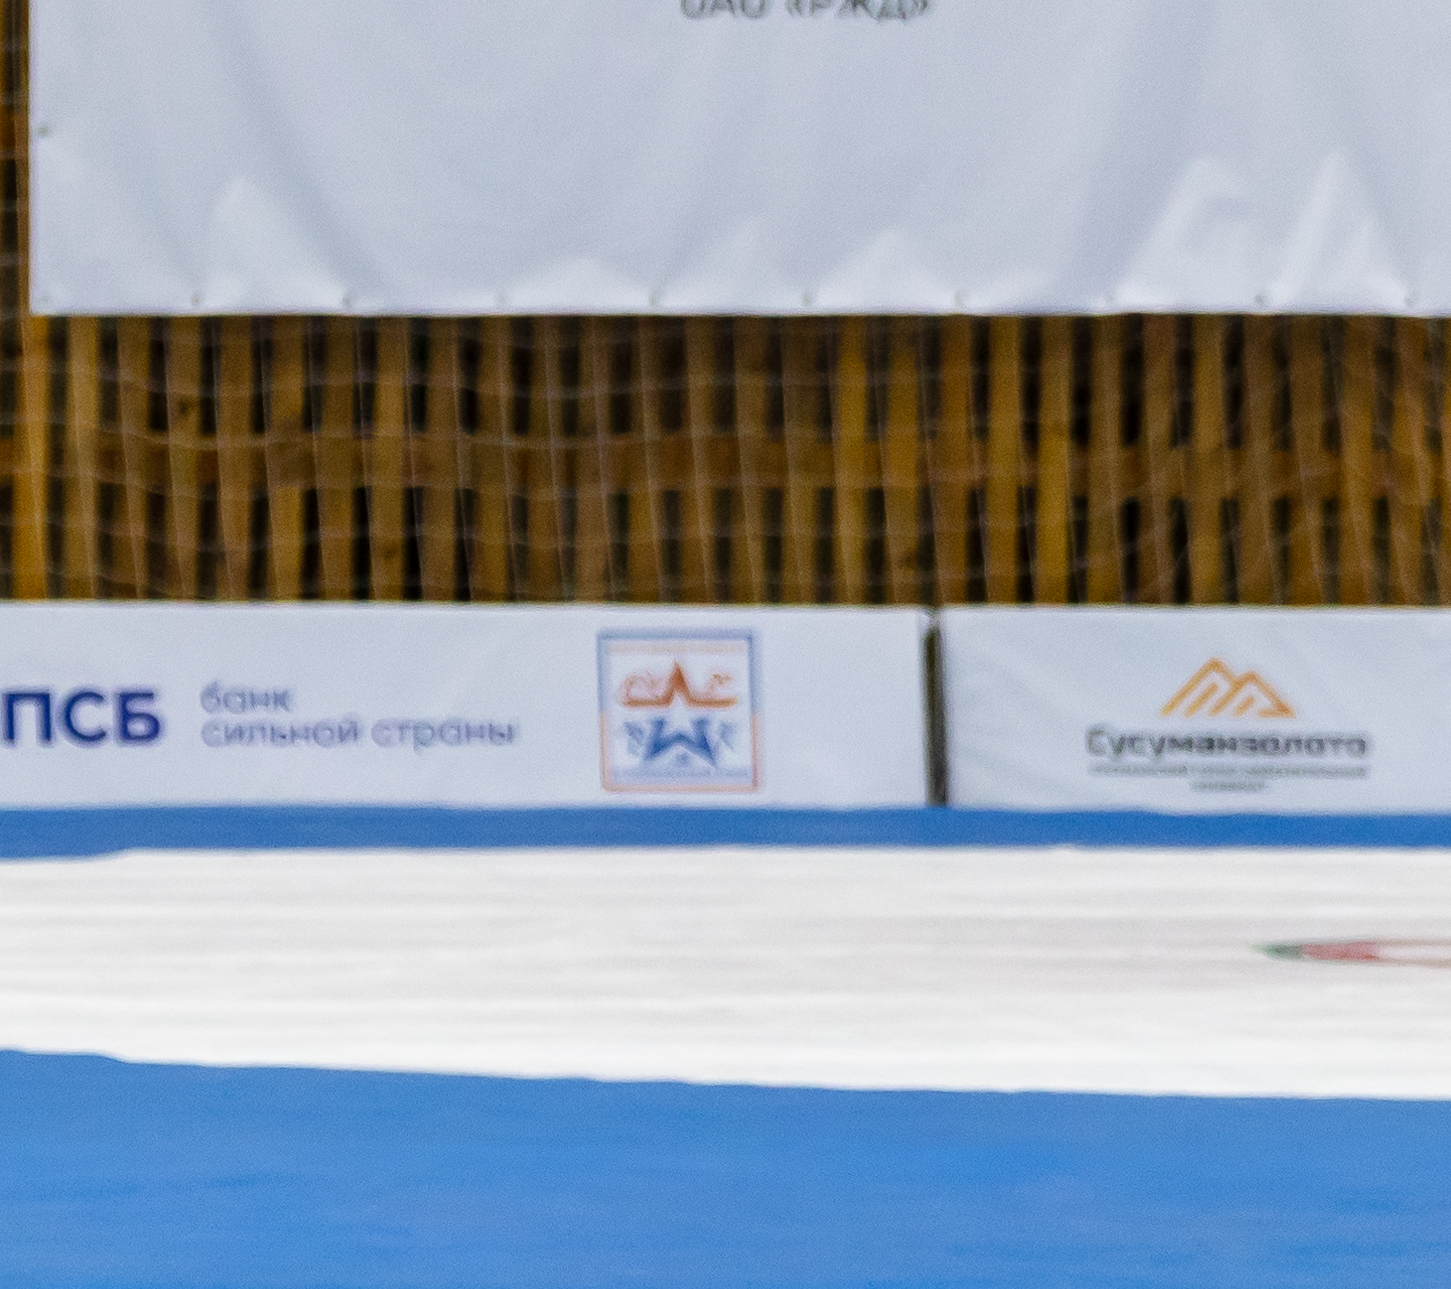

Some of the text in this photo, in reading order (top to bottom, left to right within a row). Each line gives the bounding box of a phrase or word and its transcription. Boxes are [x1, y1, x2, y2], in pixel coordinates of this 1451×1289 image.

[2, 688, 162, 746] ПСБ
[201, 681, 291, 713] банк
[201, 713, 517, 755] сильной страны
